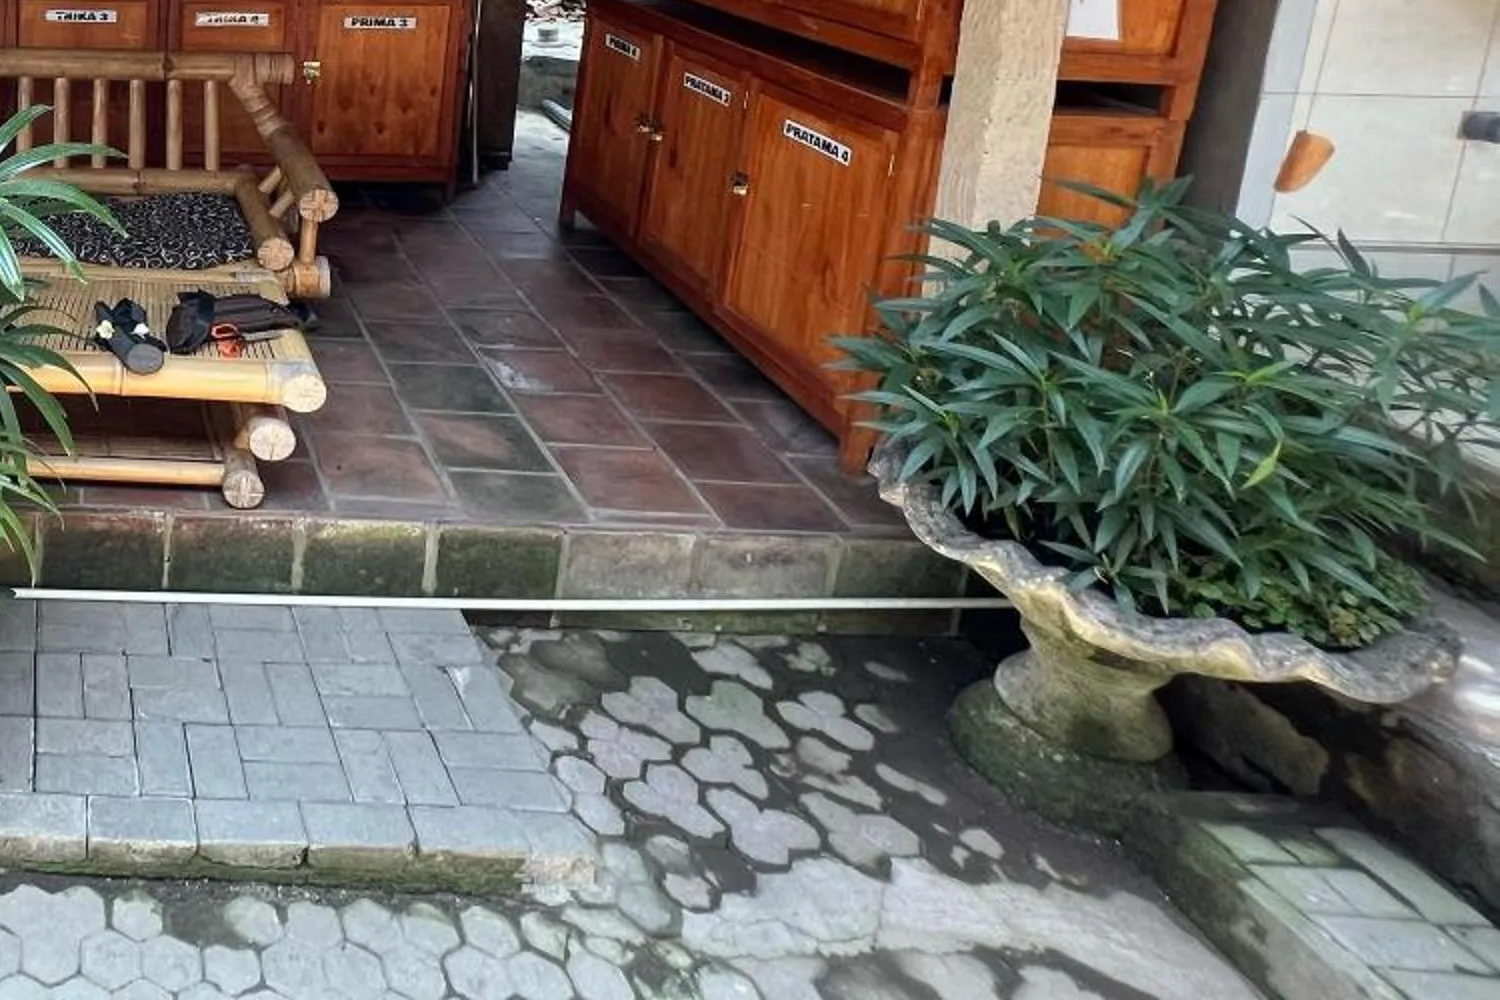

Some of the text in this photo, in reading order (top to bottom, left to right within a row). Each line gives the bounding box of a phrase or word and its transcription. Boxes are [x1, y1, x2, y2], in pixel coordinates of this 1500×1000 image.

[55, 11, 97, 21] THIKA
[351, 17, 396, 27] PRIMA
[685, 75, 723, 101] PRATAMA
[785, 123, 839, 159] PRATAMA
